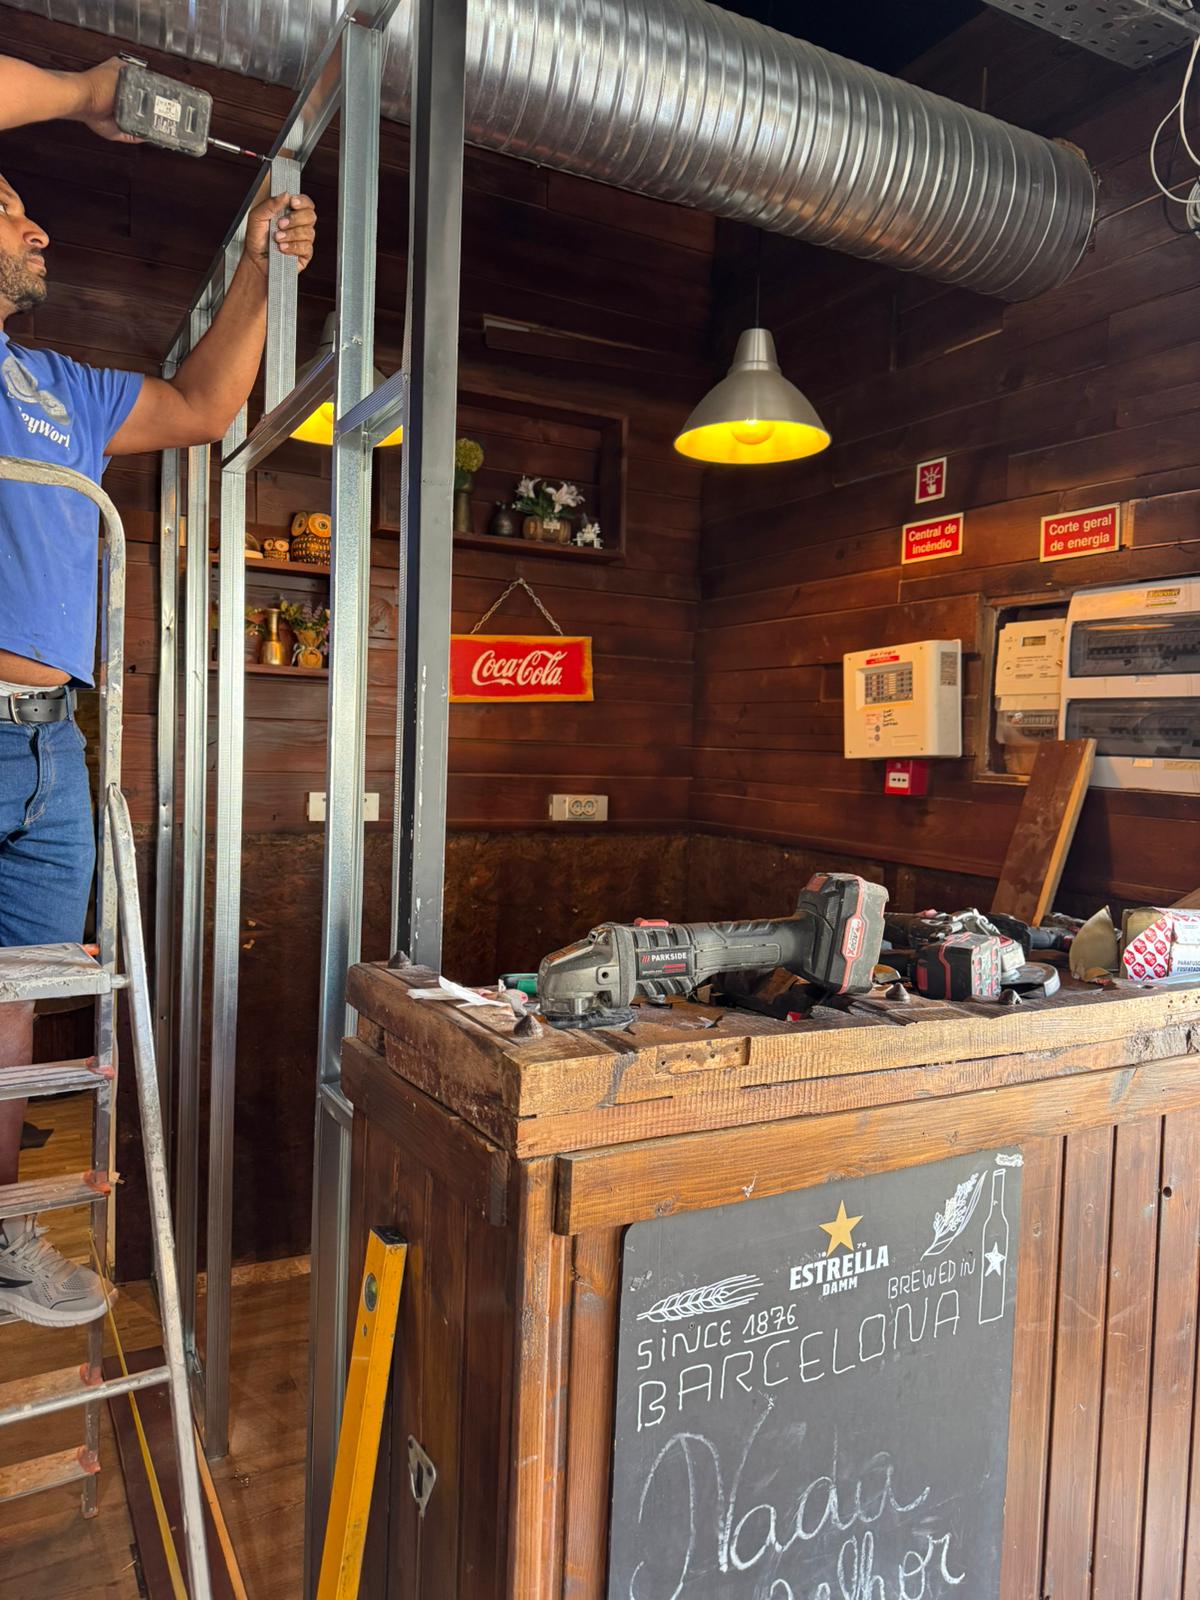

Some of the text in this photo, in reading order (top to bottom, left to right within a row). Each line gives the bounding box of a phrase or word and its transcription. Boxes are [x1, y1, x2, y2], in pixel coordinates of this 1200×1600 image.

[908, 523, 957, 542] Central de
[1048, 513, 1112, 536] Corte geral
[912, 538, 953, 555] incêndio
[1050, 532, 1110, 552] de energia
[471, 649, 569, 687] Coca-Cola
[651, 951, 688, 962] PARKSIDE
[788, 1245, 890, 1291] ESTRELLA
[887, 1259, 957, 1299] BREWED
[822, 1276, 858, 1296] DAMM
[742, 1303, 798, 1336] 1876
[636, 1289, 961, 1432] BARCELONA
